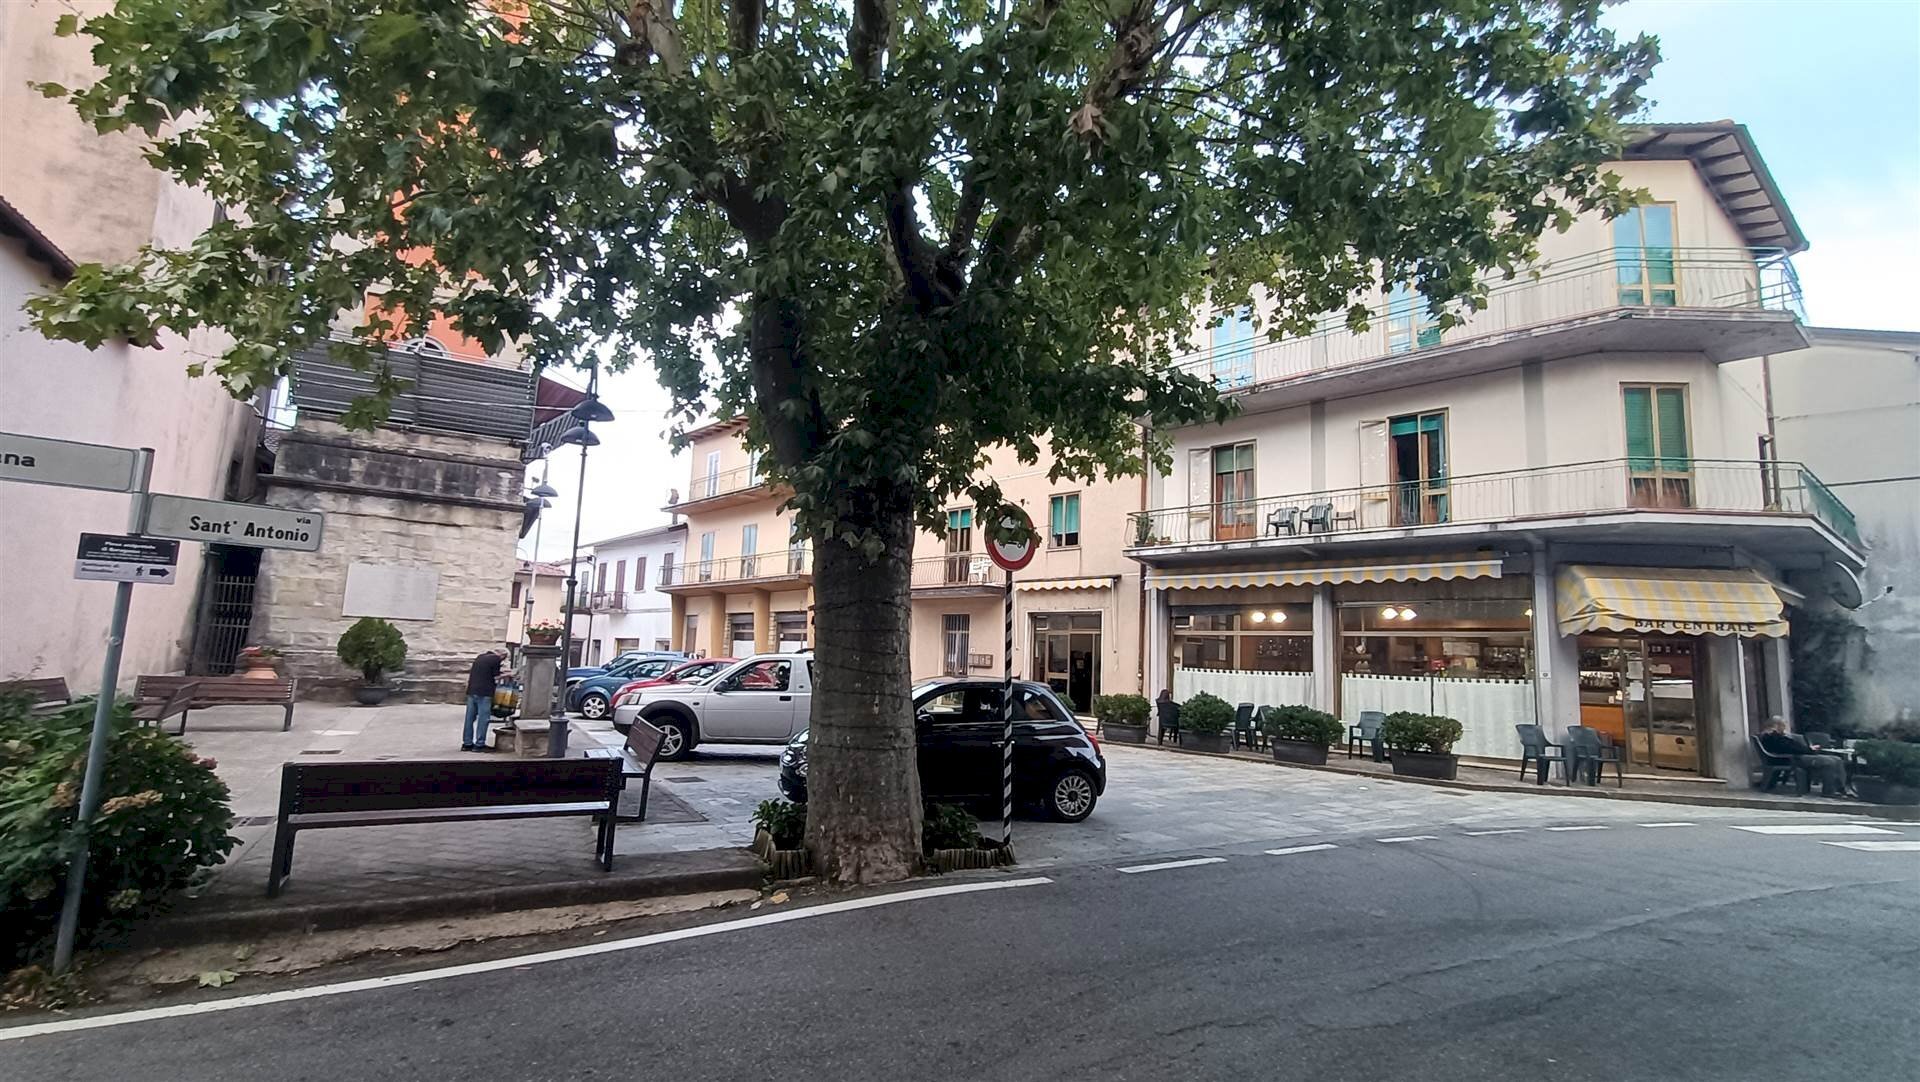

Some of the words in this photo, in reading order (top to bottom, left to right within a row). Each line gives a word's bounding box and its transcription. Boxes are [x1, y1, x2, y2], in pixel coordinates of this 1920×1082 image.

[0, 453, 35, 467] na
[296, 517, 311, 525] via
[189, 515, 237, 535] Sant'
[243, 522, 309, 542] Antonio
[1634, 619, 1665, 629] BAR
[1672, 620, 1757, 632] CENTRALE
